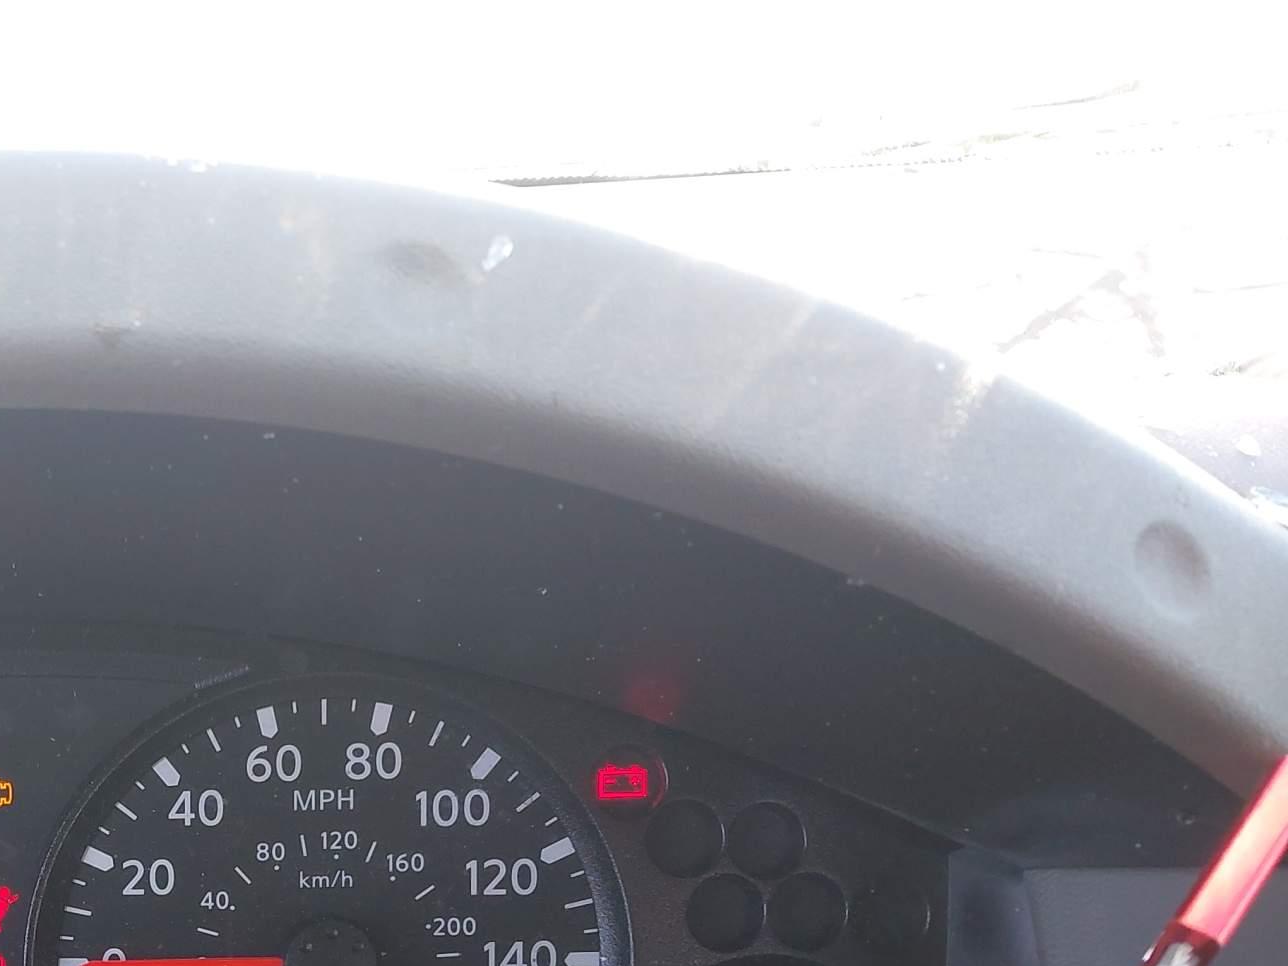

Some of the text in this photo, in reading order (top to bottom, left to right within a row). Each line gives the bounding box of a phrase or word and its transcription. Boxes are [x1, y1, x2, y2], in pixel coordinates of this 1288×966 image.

[246, 744, 302, 783] 60
[345, 742, 403, 780] 80
[168, 789, 225, 826] 40
[293, 789, 355, 811] MPH
[415, 789, 491, 826] 100
[256, 842, 286, 863] 80
[320, 831, 358, 852] 120
[386, 852, 425, 873] 160
[121, 859, 175, 896] 20
[299, 868, 354, 889] km/h
[465, 858, 539, 896] 120
[200, 891, 231, 911] 40
[433, 916, 477, 937] 200
